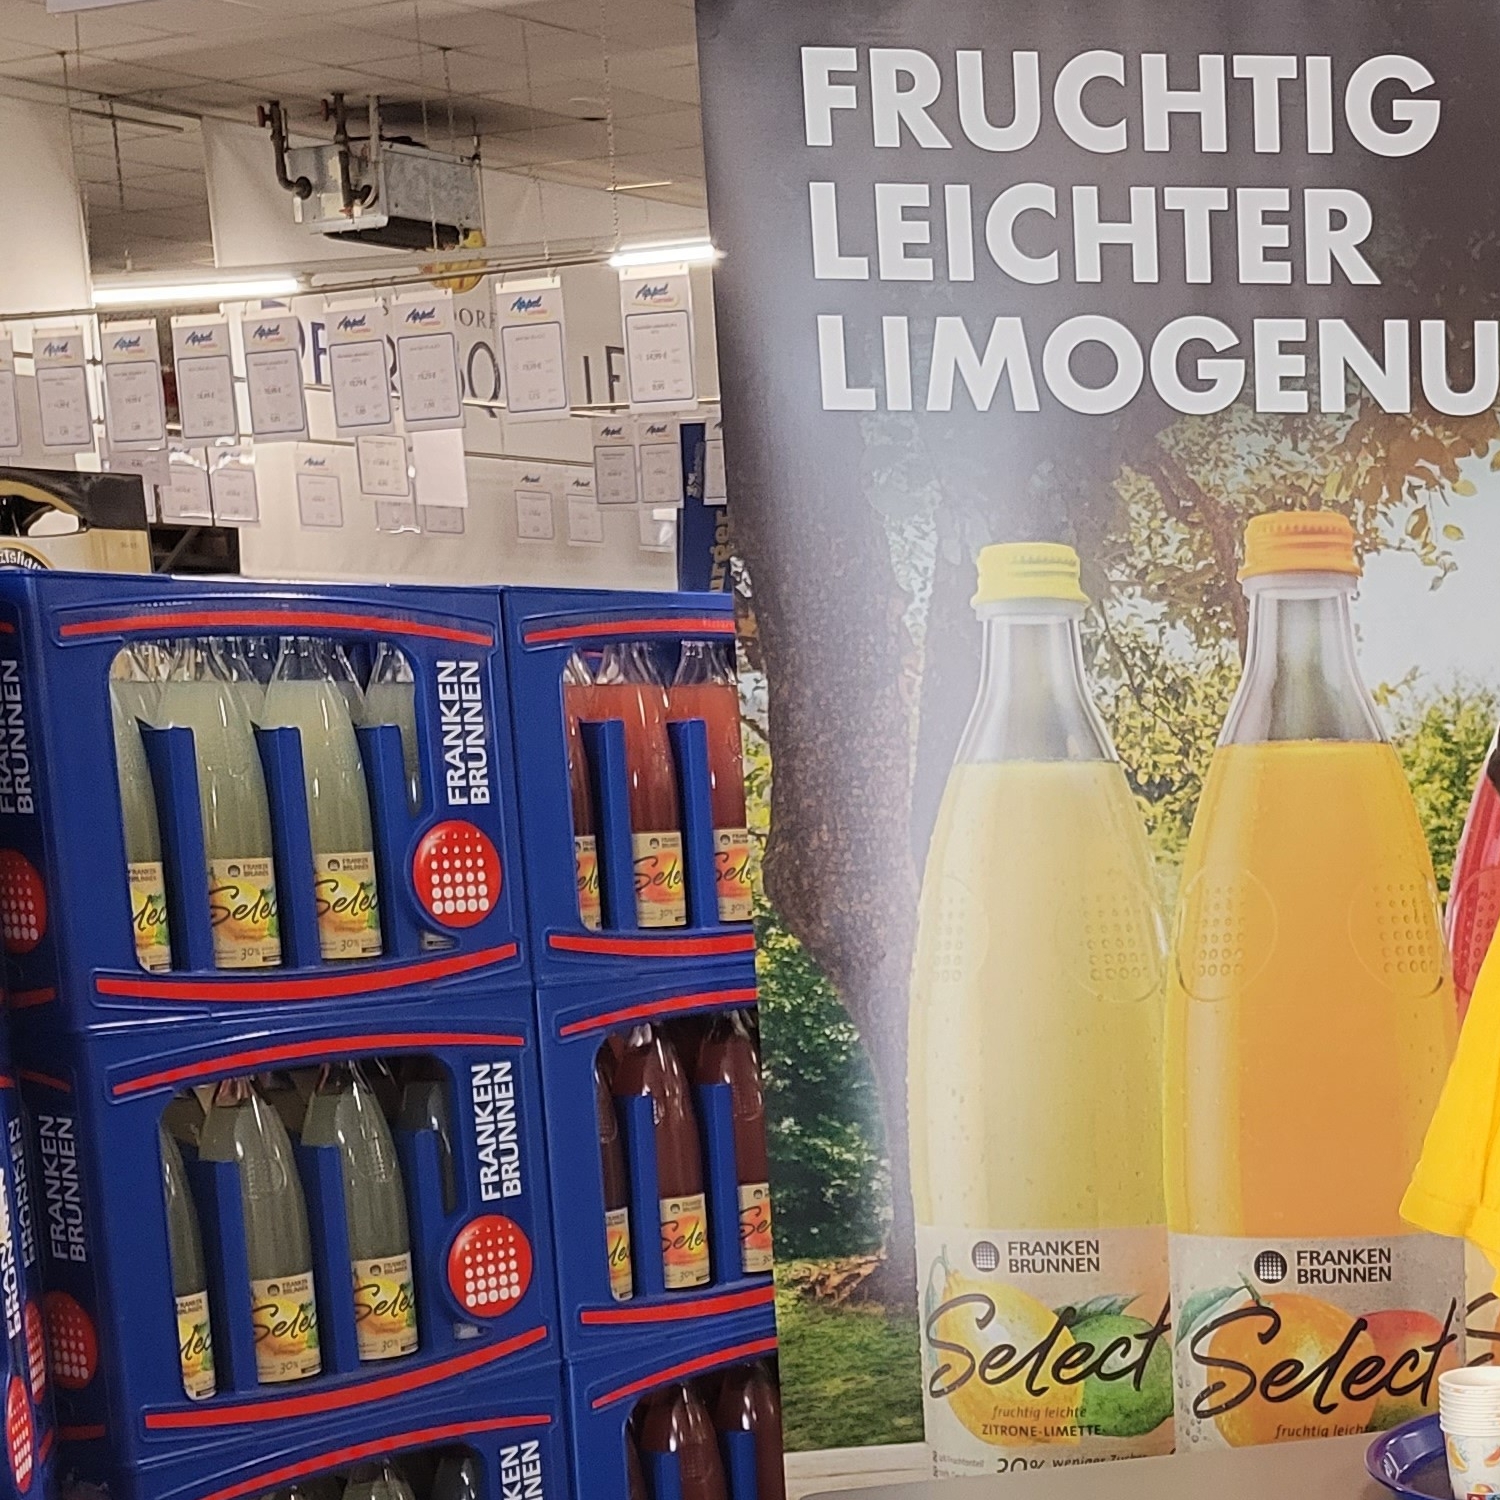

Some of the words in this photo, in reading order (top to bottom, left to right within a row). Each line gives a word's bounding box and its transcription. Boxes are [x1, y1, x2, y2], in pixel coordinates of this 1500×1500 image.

[801, 47, 1440, 156] FRUCHTIG
[810, 182, 1381, 286] LEICHTER
[2, 660, 34, 814] BRUNNEN
[436, 660, 468, 805] FRANKEN
[459, 661, 490, 804] BRUNNEN
[209, 885, 277, 927] Selec
[314, 878, 377, 918] Selec
[470, 1063, 501, 1202] FRANKEN
[493, 1061, 522, 1198] BRUNNEN
[39, 1115, 68, 1261] FRANKEN
[56, 1117, 86, 1263] BRUNNEN
[1008, 1240, 1100, 1256] FRANKEN
[1008, 1257, 1100, 1273] BRUNNEN
[1296, 1248, 1392, 1266] FRANKEN
[1297, 1265, 1392, 1285] BRUNNEN
[253, 1302, 318, 1344] Selec
[353, 1283, 414, 1323] Selec
[927, 1292, 1171, 1398] Select
[1190, 1297, 1458, 1419] Select
[982, 1424, 1102, 1437] ZITRONE-LIMETTE
[992, 1406, 1041, 1421] fruchtig
[1044, 1405, 1087, 1418] leichte
